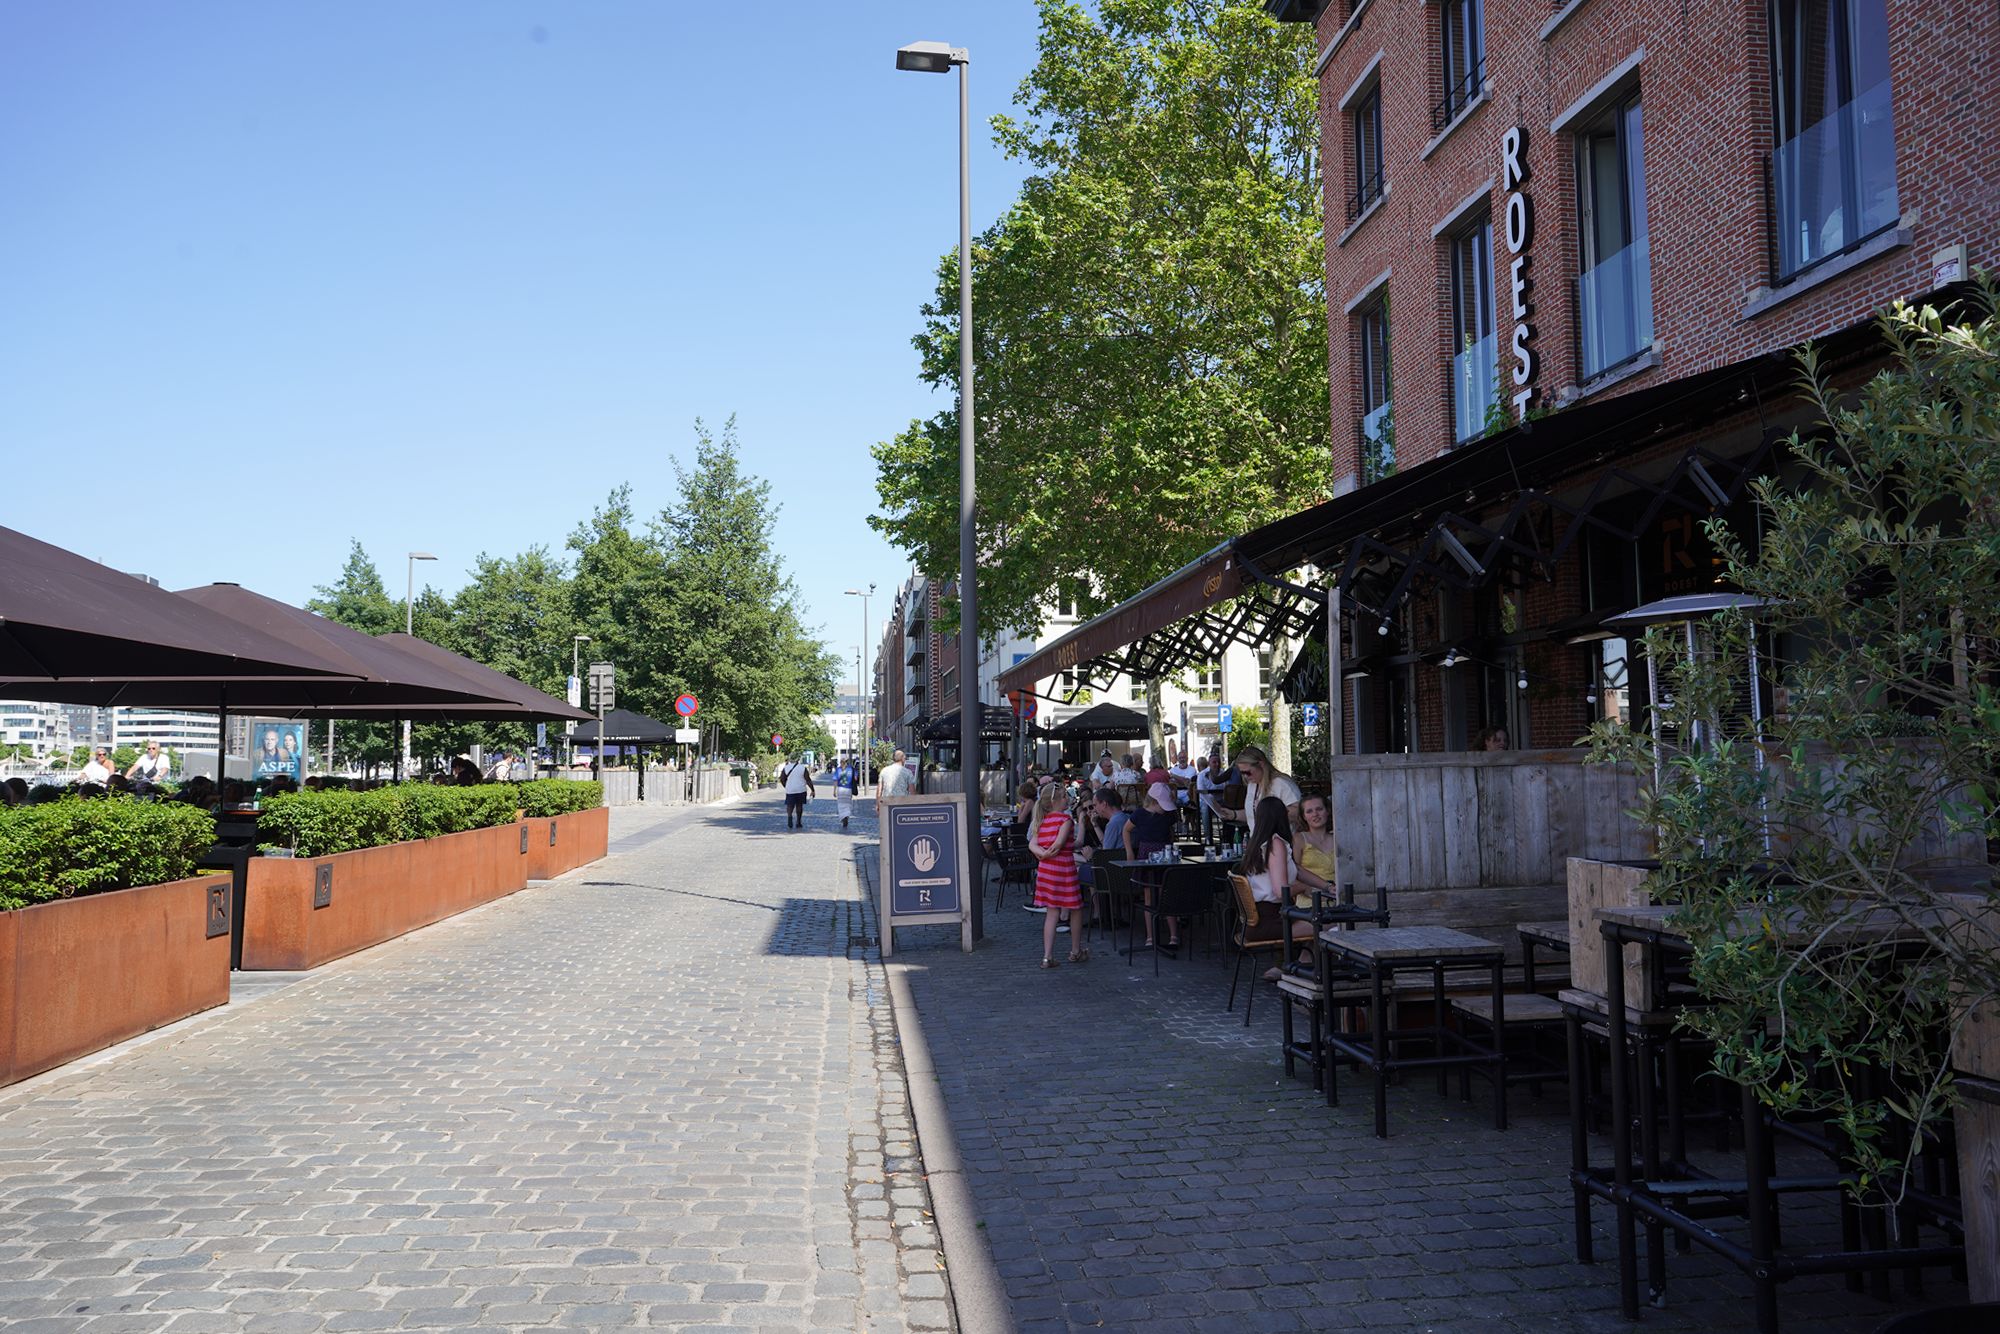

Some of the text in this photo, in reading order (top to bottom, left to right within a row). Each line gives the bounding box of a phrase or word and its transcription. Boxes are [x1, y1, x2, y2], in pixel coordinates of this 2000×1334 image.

[1503, 126, 1532, 422] ROEST
[1220, 708, 1230, 722] P
[1306, 708, 1316, 722] P
[258, 761, 296, 772] ASPE
